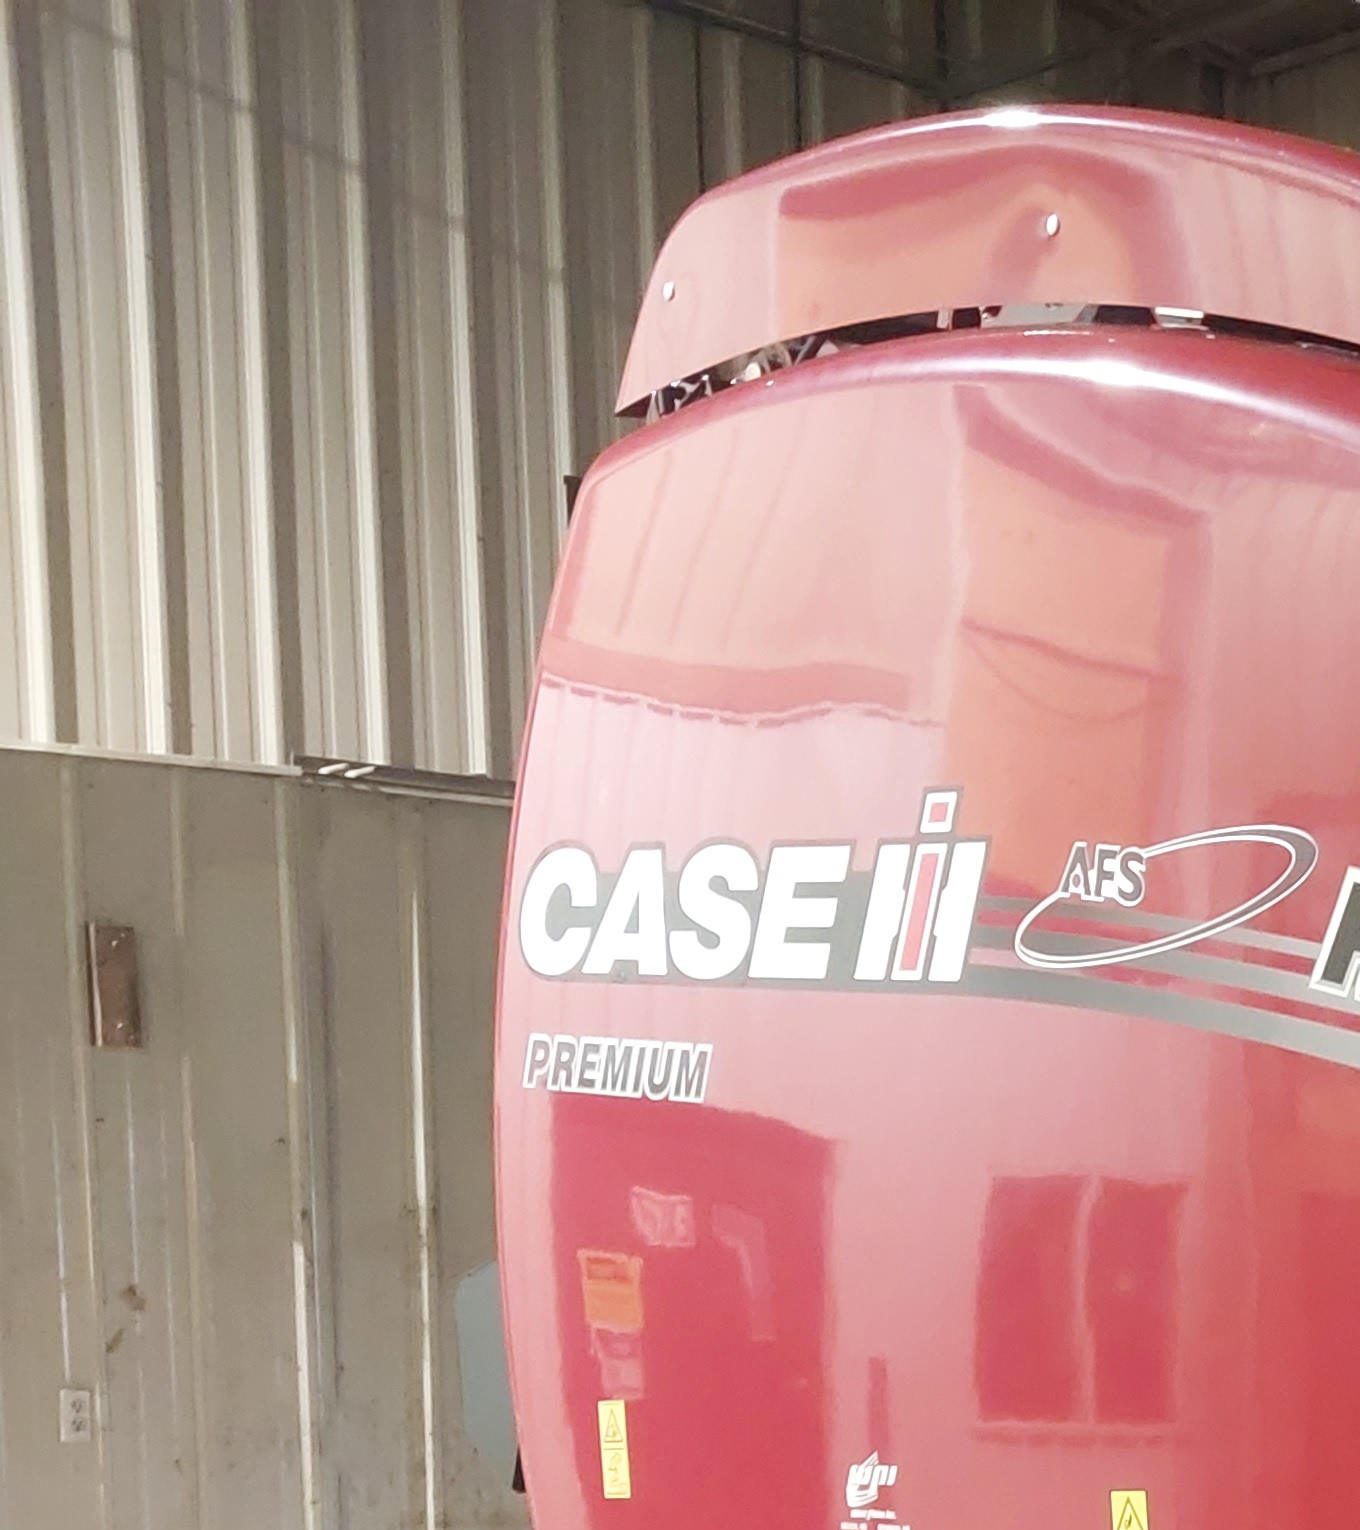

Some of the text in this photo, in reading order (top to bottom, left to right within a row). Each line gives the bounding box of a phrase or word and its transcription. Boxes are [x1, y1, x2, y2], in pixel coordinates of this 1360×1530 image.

[1060, 840, 1146, 905] AFS
[519, 843, 851, 980] CASE
[523, 1032, 712, 1103] PREMIUM
